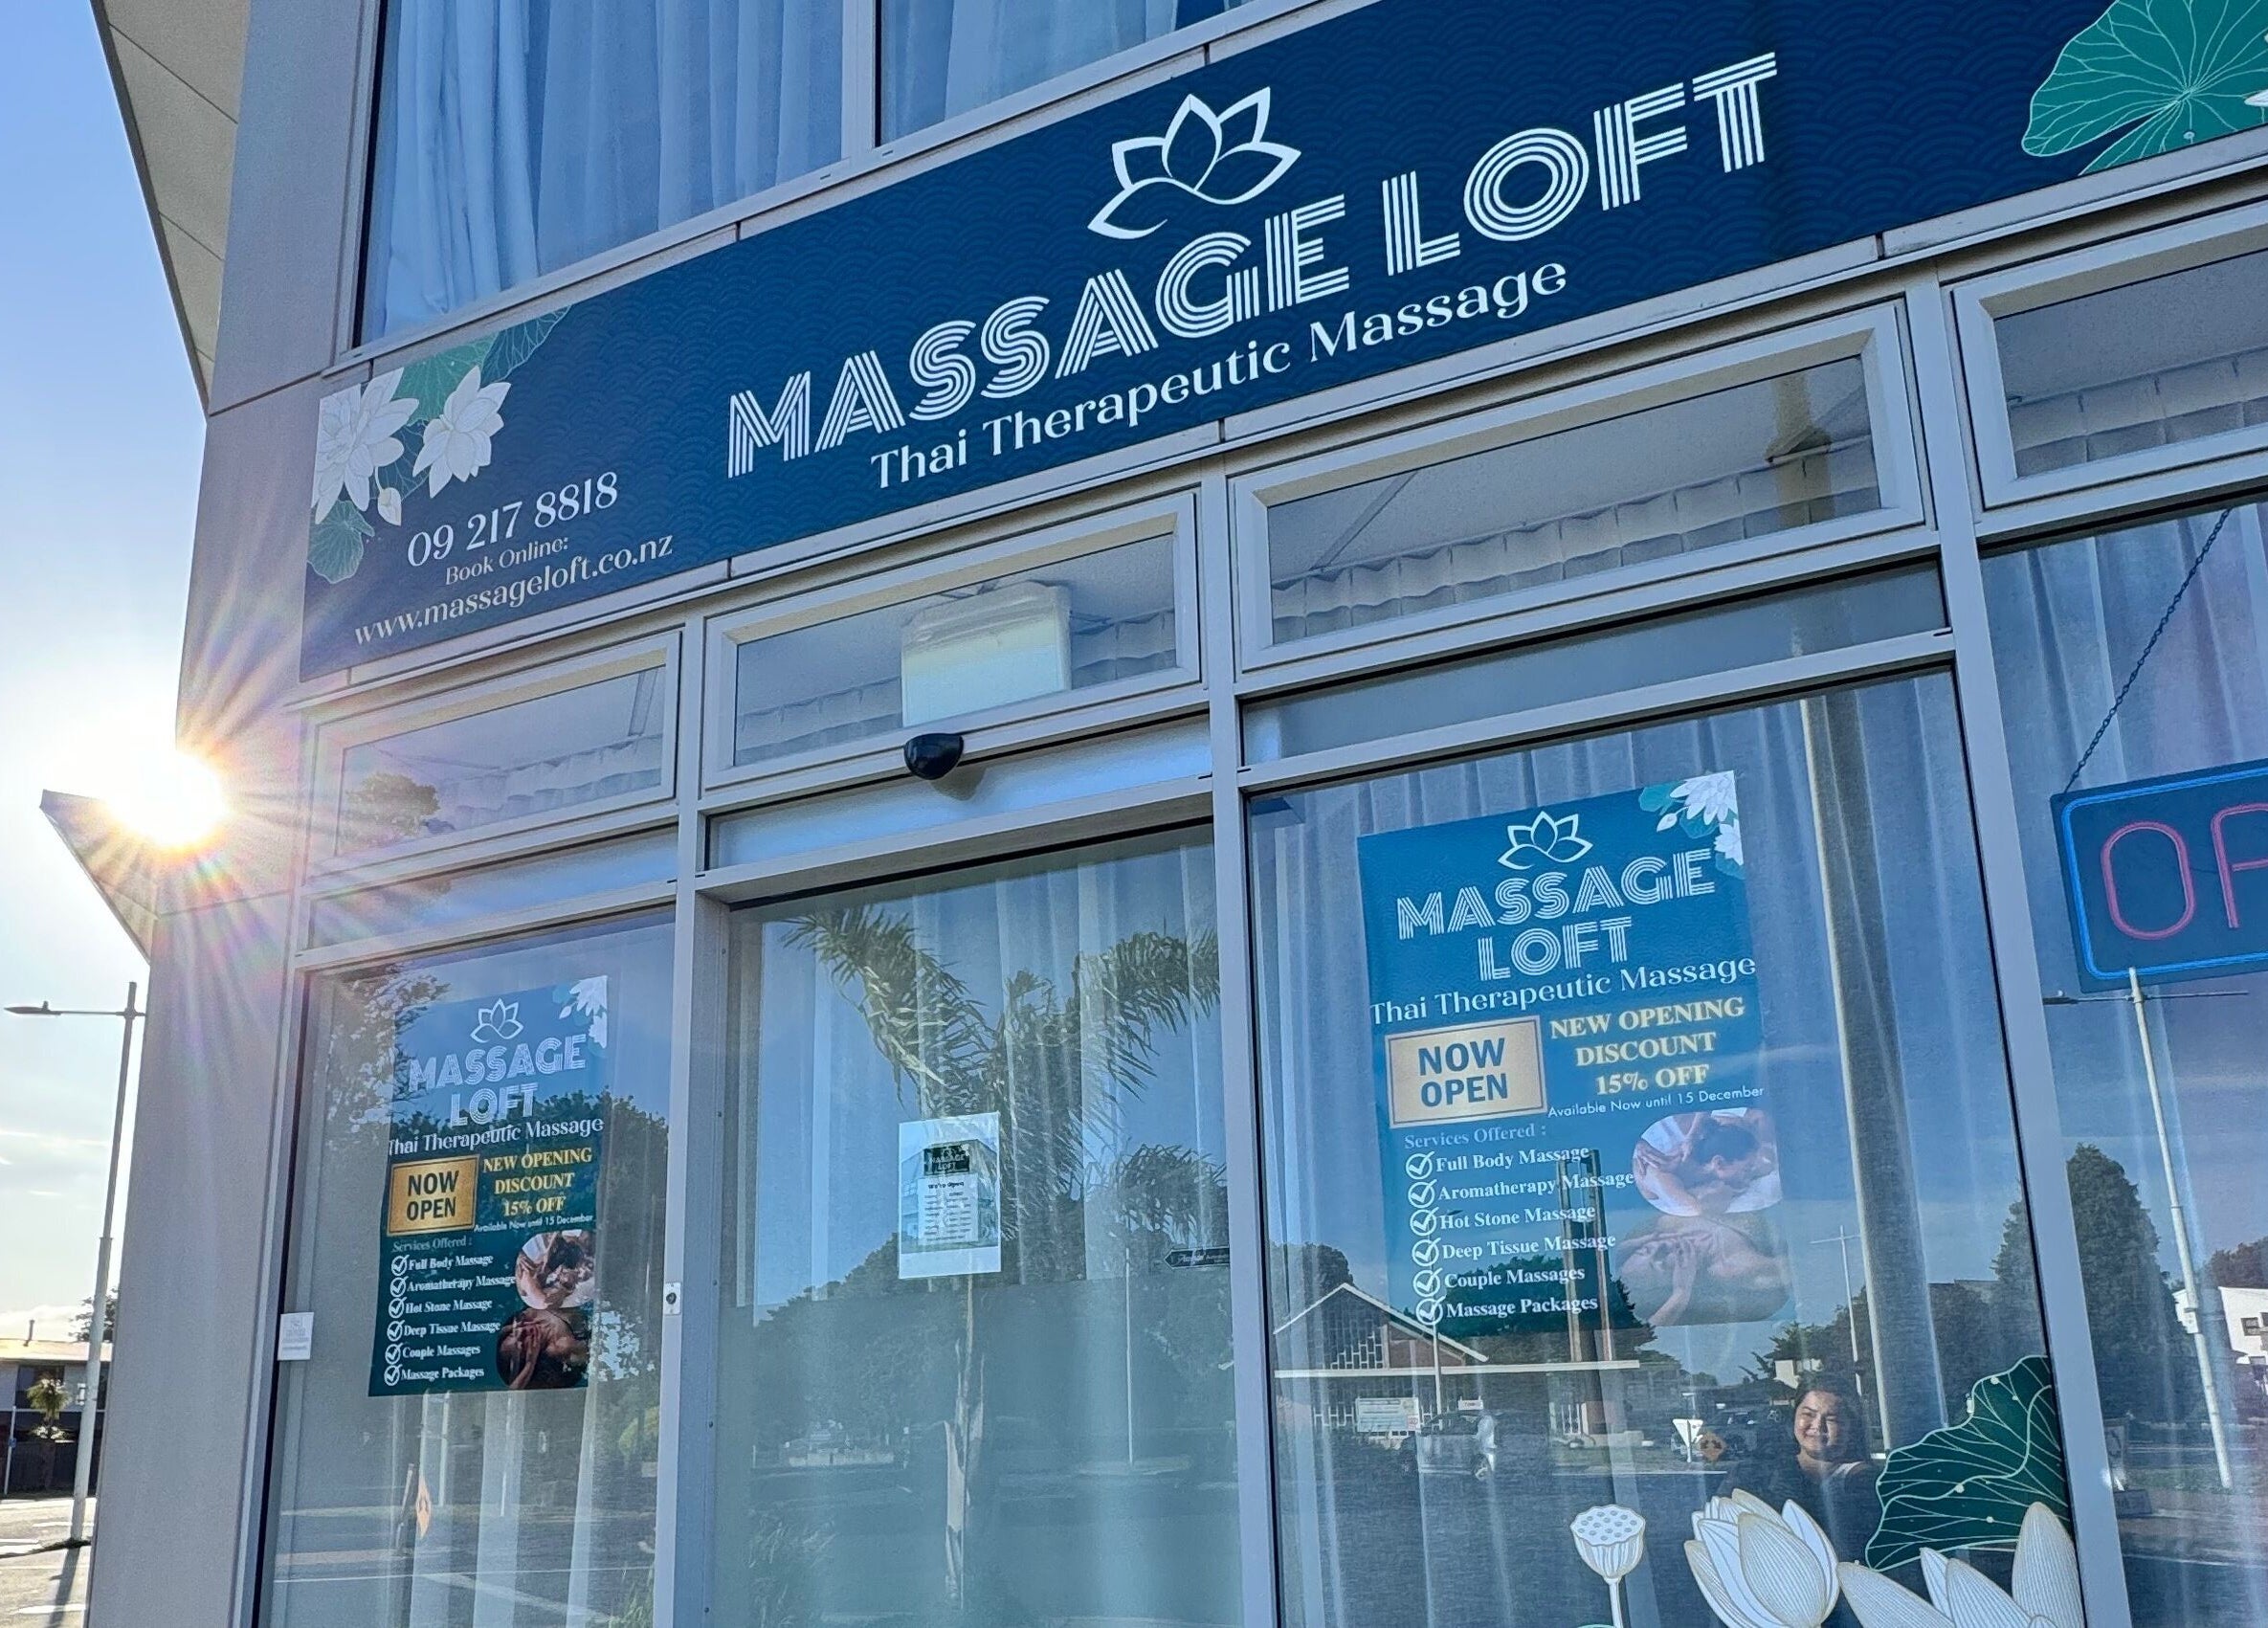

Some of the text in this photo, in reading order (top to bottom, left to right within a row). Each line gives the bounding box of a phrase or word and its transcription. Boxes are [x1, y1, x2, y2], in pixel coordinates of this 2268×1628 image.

[727, 52, 1777, 478] MASSAGE LOFT
[871, 261, 1568, 488] Thai Therapeutic Massage
[408, 471, 618, 567] 09 217 8818
[445, 535, 569, 586] Book Online:
[354, 534, 674, 645] www.massageloft.co.nz
[1396, 848, 1715, 940] MASSAGE
[1478, 916, 1633, 981] LOFT
[1369, 956, 1757, 1025] Thai Therapeutic Massage
[1549, 996, 1745, 1039] NEW OPENING
[409, 1034, 587, 1092] MASSAGE
[1418, 1037, 1506, 1076] NOW
[1575, 1032, 1717, 1067] DISCOUNT
[1420, 1073, 1509, 1108] OPEN
[1595, 1063, 1711, 1095] 15% OFF
[450, 1082, 538, 1127] LOFT
[1547, 1084, 1765, 1118] Available Now until 15 December
[388, 1118, 605, 1156] Thai Therapeutic Massage
[1404, 1131, 1471, 1150] Services
[482, 1148, 592, 1173] NEW OPENING
[1435, 1146, 1590, 1172] Full Body Massage
[408, 1170, 459, 1196] NOW
[494, 1172, 575, 1194] DISCOUNT
[1437, 1171, 1634, 1201] Aromatherapy Massage
[406, 1197, 457, 1220] OPEN
[502, 1195, 567, 1216] 15% OFF
[1438, 1204, 1596, 1230] Hot Stone Massage
[1442, 1234, 1616, 1260] Deep Tissue Massage
[409, 1255, 494, 1270] Full Body Massage
[407, 1276, 515, 1292] Aromatherapy Massage
[1444, 1266, 1586, 1290] Couple Massages
[405, 1299, 492, 1313] Hot Stone Massage
[1447, 1296, 1598, 1318] Massage Packages
[403, 1325, 427, 1337] Deep
[460, 1321, 500, 1333] Massage
[402, 1345, 480, 1358] Couple Massages
[401, 1367, 484, 1380] Massage Packages
